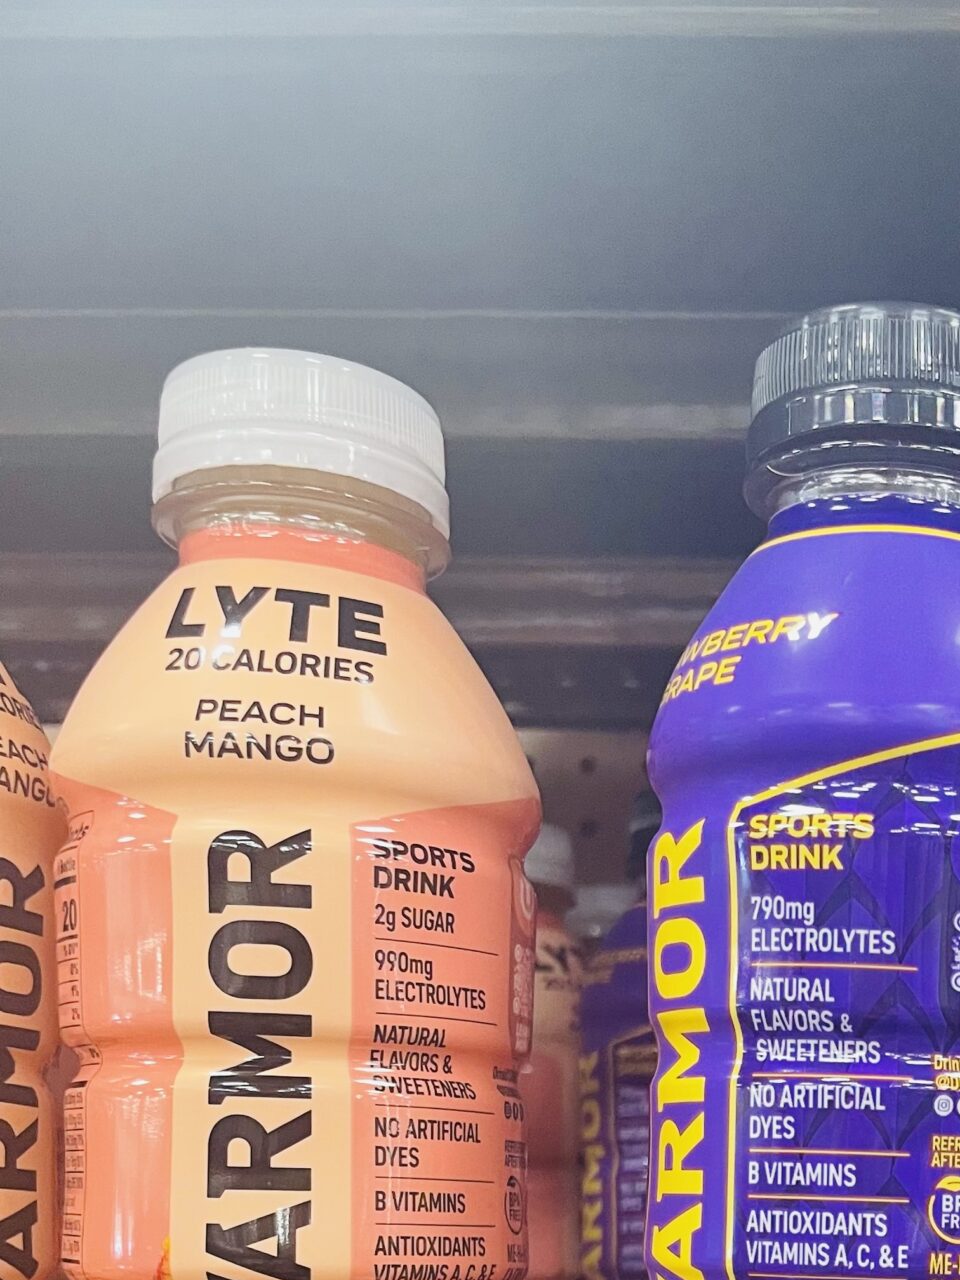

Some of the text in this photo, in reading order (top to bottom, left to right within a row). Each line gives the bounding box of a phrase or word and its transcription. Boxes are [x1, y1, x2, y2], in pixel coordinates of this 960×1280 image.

[165, 586, 389, 656] LYTE
[165, 647, 374, 684] 20 CALORIES
[194, 699, 325, 728] PEACH
[184, 731, 335, 765] MANGO
[749, 813, 874, 840] SPORTS
[373, 838, 476, 873] SPORTS
[750, 845, 844, 871] DRINK
[373, 866, 455, 899] DRINK
[375, 904, 455, 934] 2g SUGAR
[751, 896, 815, 926] 790mg
[751, 927, 896, 955] ELECTROLYTES
[375, 949, 433, 981] 990mg
[375, 979, 486, 1010] ELECTROLYTES
[750, 977, 835, 1003] NATURAL
[751, 1009, 834, 1033] FLAVORS
[373, 1024, 446, 1048] NATURAL
[370, 1049, 439, 1073] FLAVORS
[756, 1040, 881, 1064] SWEETENERS
[373, 1075, 476, 1100] SWEETENERS
[749, 1085, 886, 1111] NO ARTIFICIAL
[375, 1117, 481, 1143] NO ARTIFICIAL
[749, 1116, 795, 1140] DYES
[375, 1146, 419, 1168] DYES
[749, 1162, 857, 1188] B VITAMINS
[375, 1191, 466, 1214] B VITAMINS
[747, 1210, 888, 1237] ANTIOXIDANTS
[374, 1236, 486, 1257] ANTIOXIDANTS
[747, 1241, 830, 1267] VITAMINS
